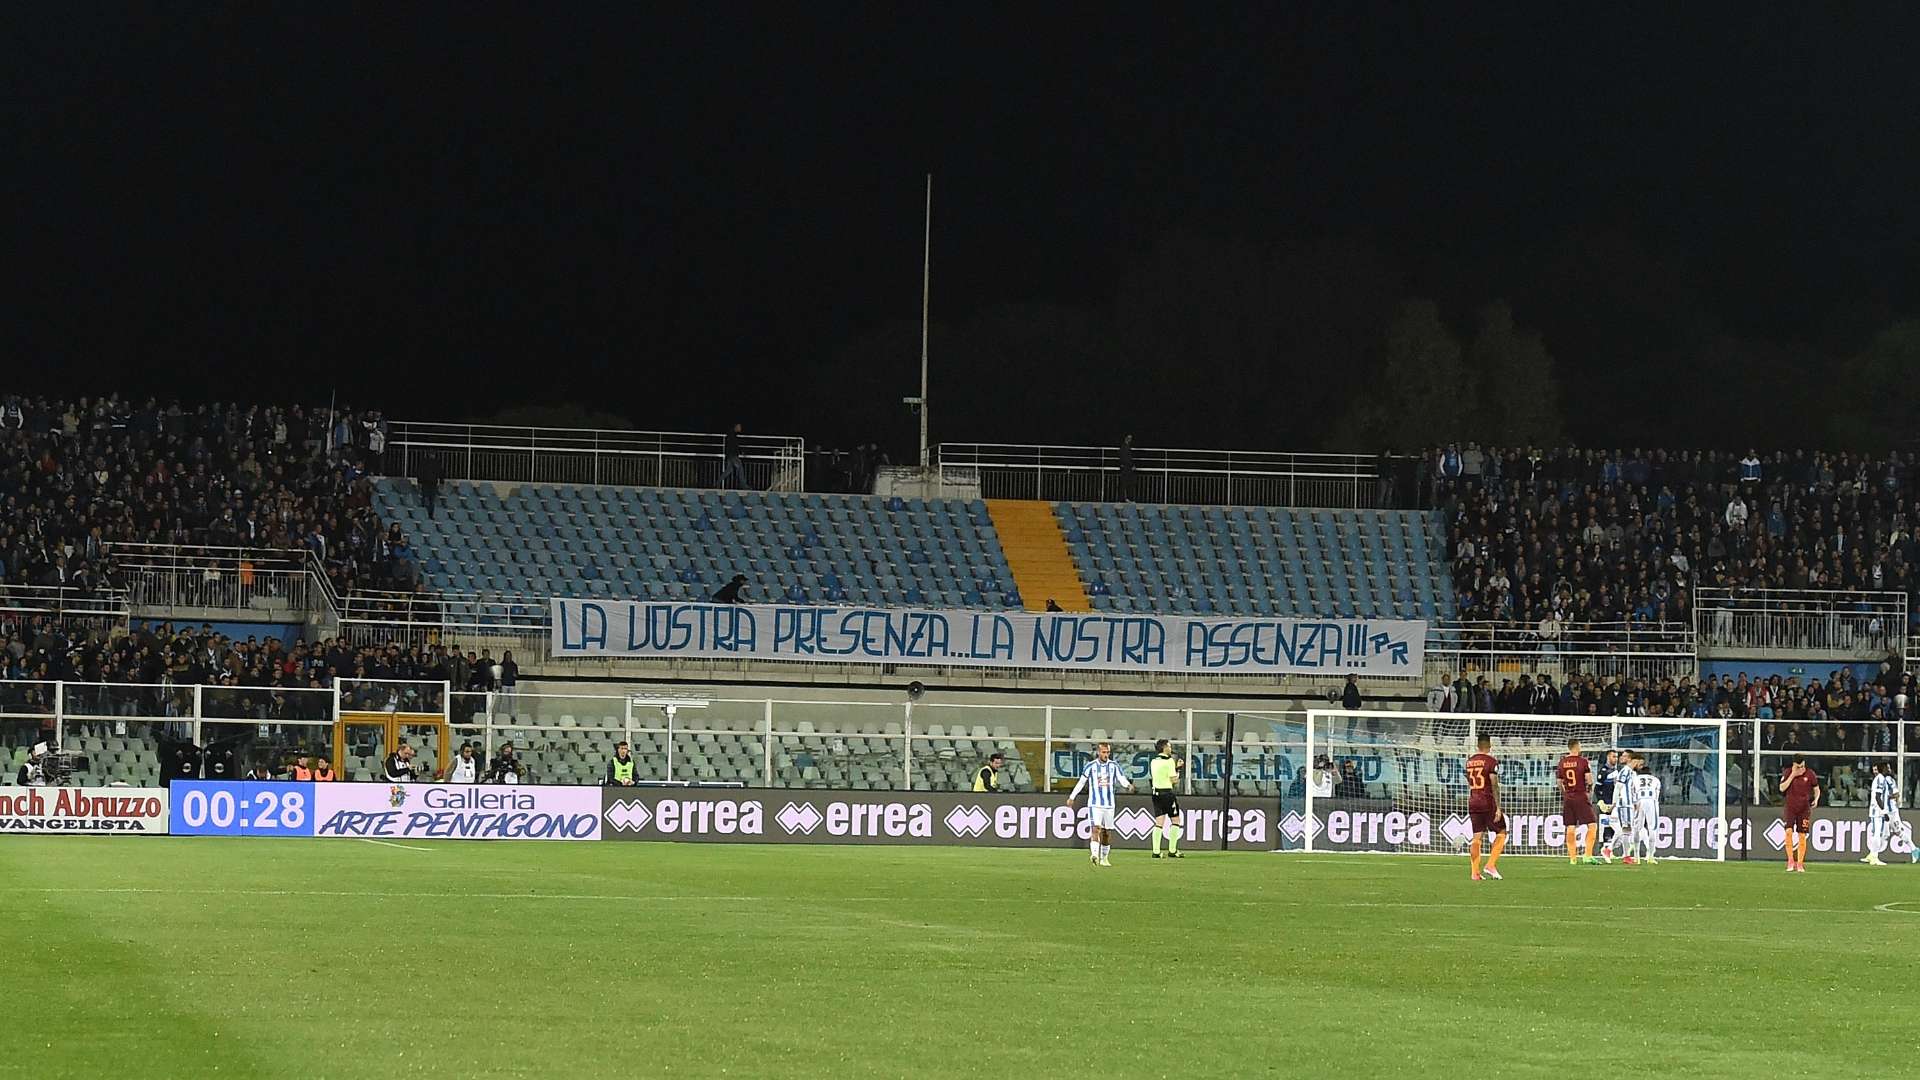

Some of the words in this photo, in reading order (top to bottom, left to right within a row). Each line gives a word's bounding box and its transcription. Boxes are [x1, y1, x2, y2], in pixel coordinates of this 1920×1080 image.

[559, 600, 607, 650] LA
[628, 605, 757, 653] VOSTRA
[1032, 616, 1166, 665] NOSTRA
[1467, 767, 1485, 789] 33
[1566, 769, 1577, 787] 9
[53, 788, 162, 818] Abruzzo
[183, 790, 305, 828] 00:28
[424, 788, 535, 810] Galleria
[319, 810, 402, 836] ARTE
[403, 811, 599, 838] PENTAGONO
